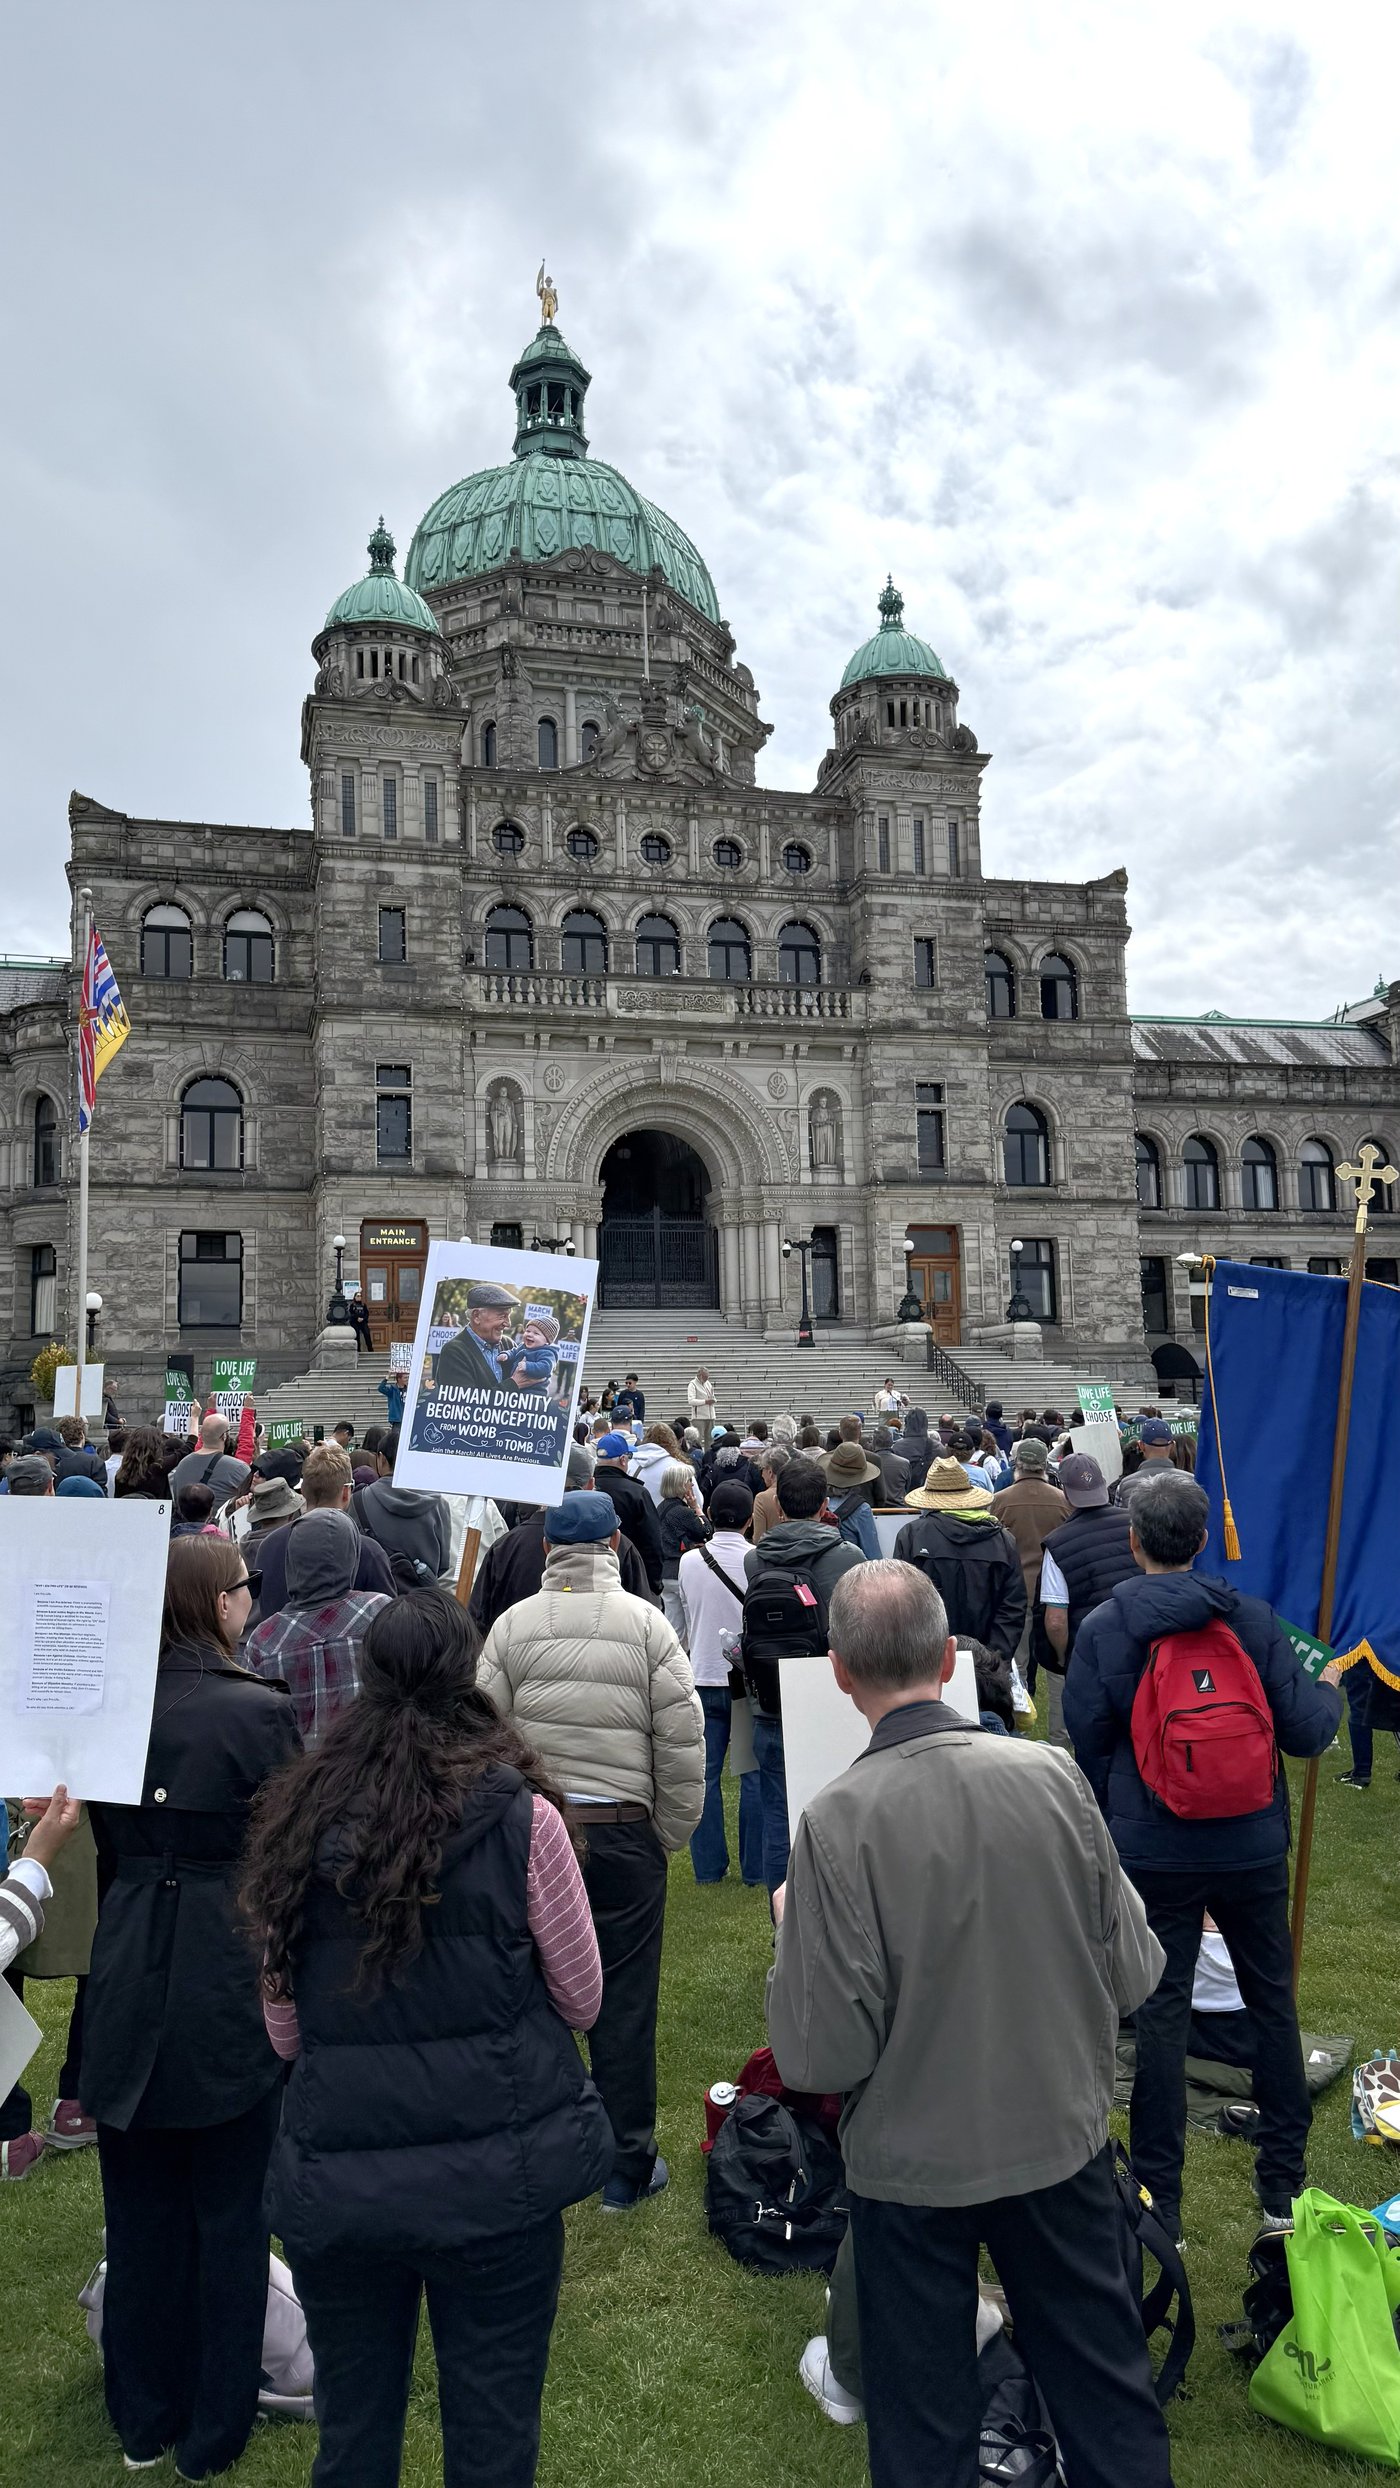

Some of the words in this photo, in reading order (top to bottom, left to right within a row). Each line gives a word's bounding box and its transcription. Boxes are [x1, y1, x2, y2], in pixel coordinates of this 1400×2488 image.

[528, 1306, 550, 1314] MARCH
[216, 1361, 237, 1375] LOVE
[240, 1361, 255, 1376] LIFE
[165, 1372, 181, 1386] LOVE
[438, 1385, 491, 1405] HUMAN
[494, 1390, 552, 1412] DIGNITY
[1078, 1387, 1095, 1399] LOVE
[1095, 1387, 1110, 1399] LIFE
[426, 1402, 471, 1422] BEGINS
[473, 1408, 558, 1431] CONCEPTION
[1085, 1411, 1113, 1422] CHOOSE
[173, 1418, 187, 1432] LIFE
[272, 1424, 290, 1440] LOVE
[291, 1422, 302, 1437] LIFE
[440, 1423, 457, 1431] FROM
[458, 1424, 496, 1438] WOMB
[1123, 1426, 1135, 1437] OVE
[1171, 1423, 1183, 1434] OVE
[1184, 1421, 1196, 1433] LIFE
[505, 1439, 533, 1453] TOMB
[158, 1504, 165, 1514] 8
